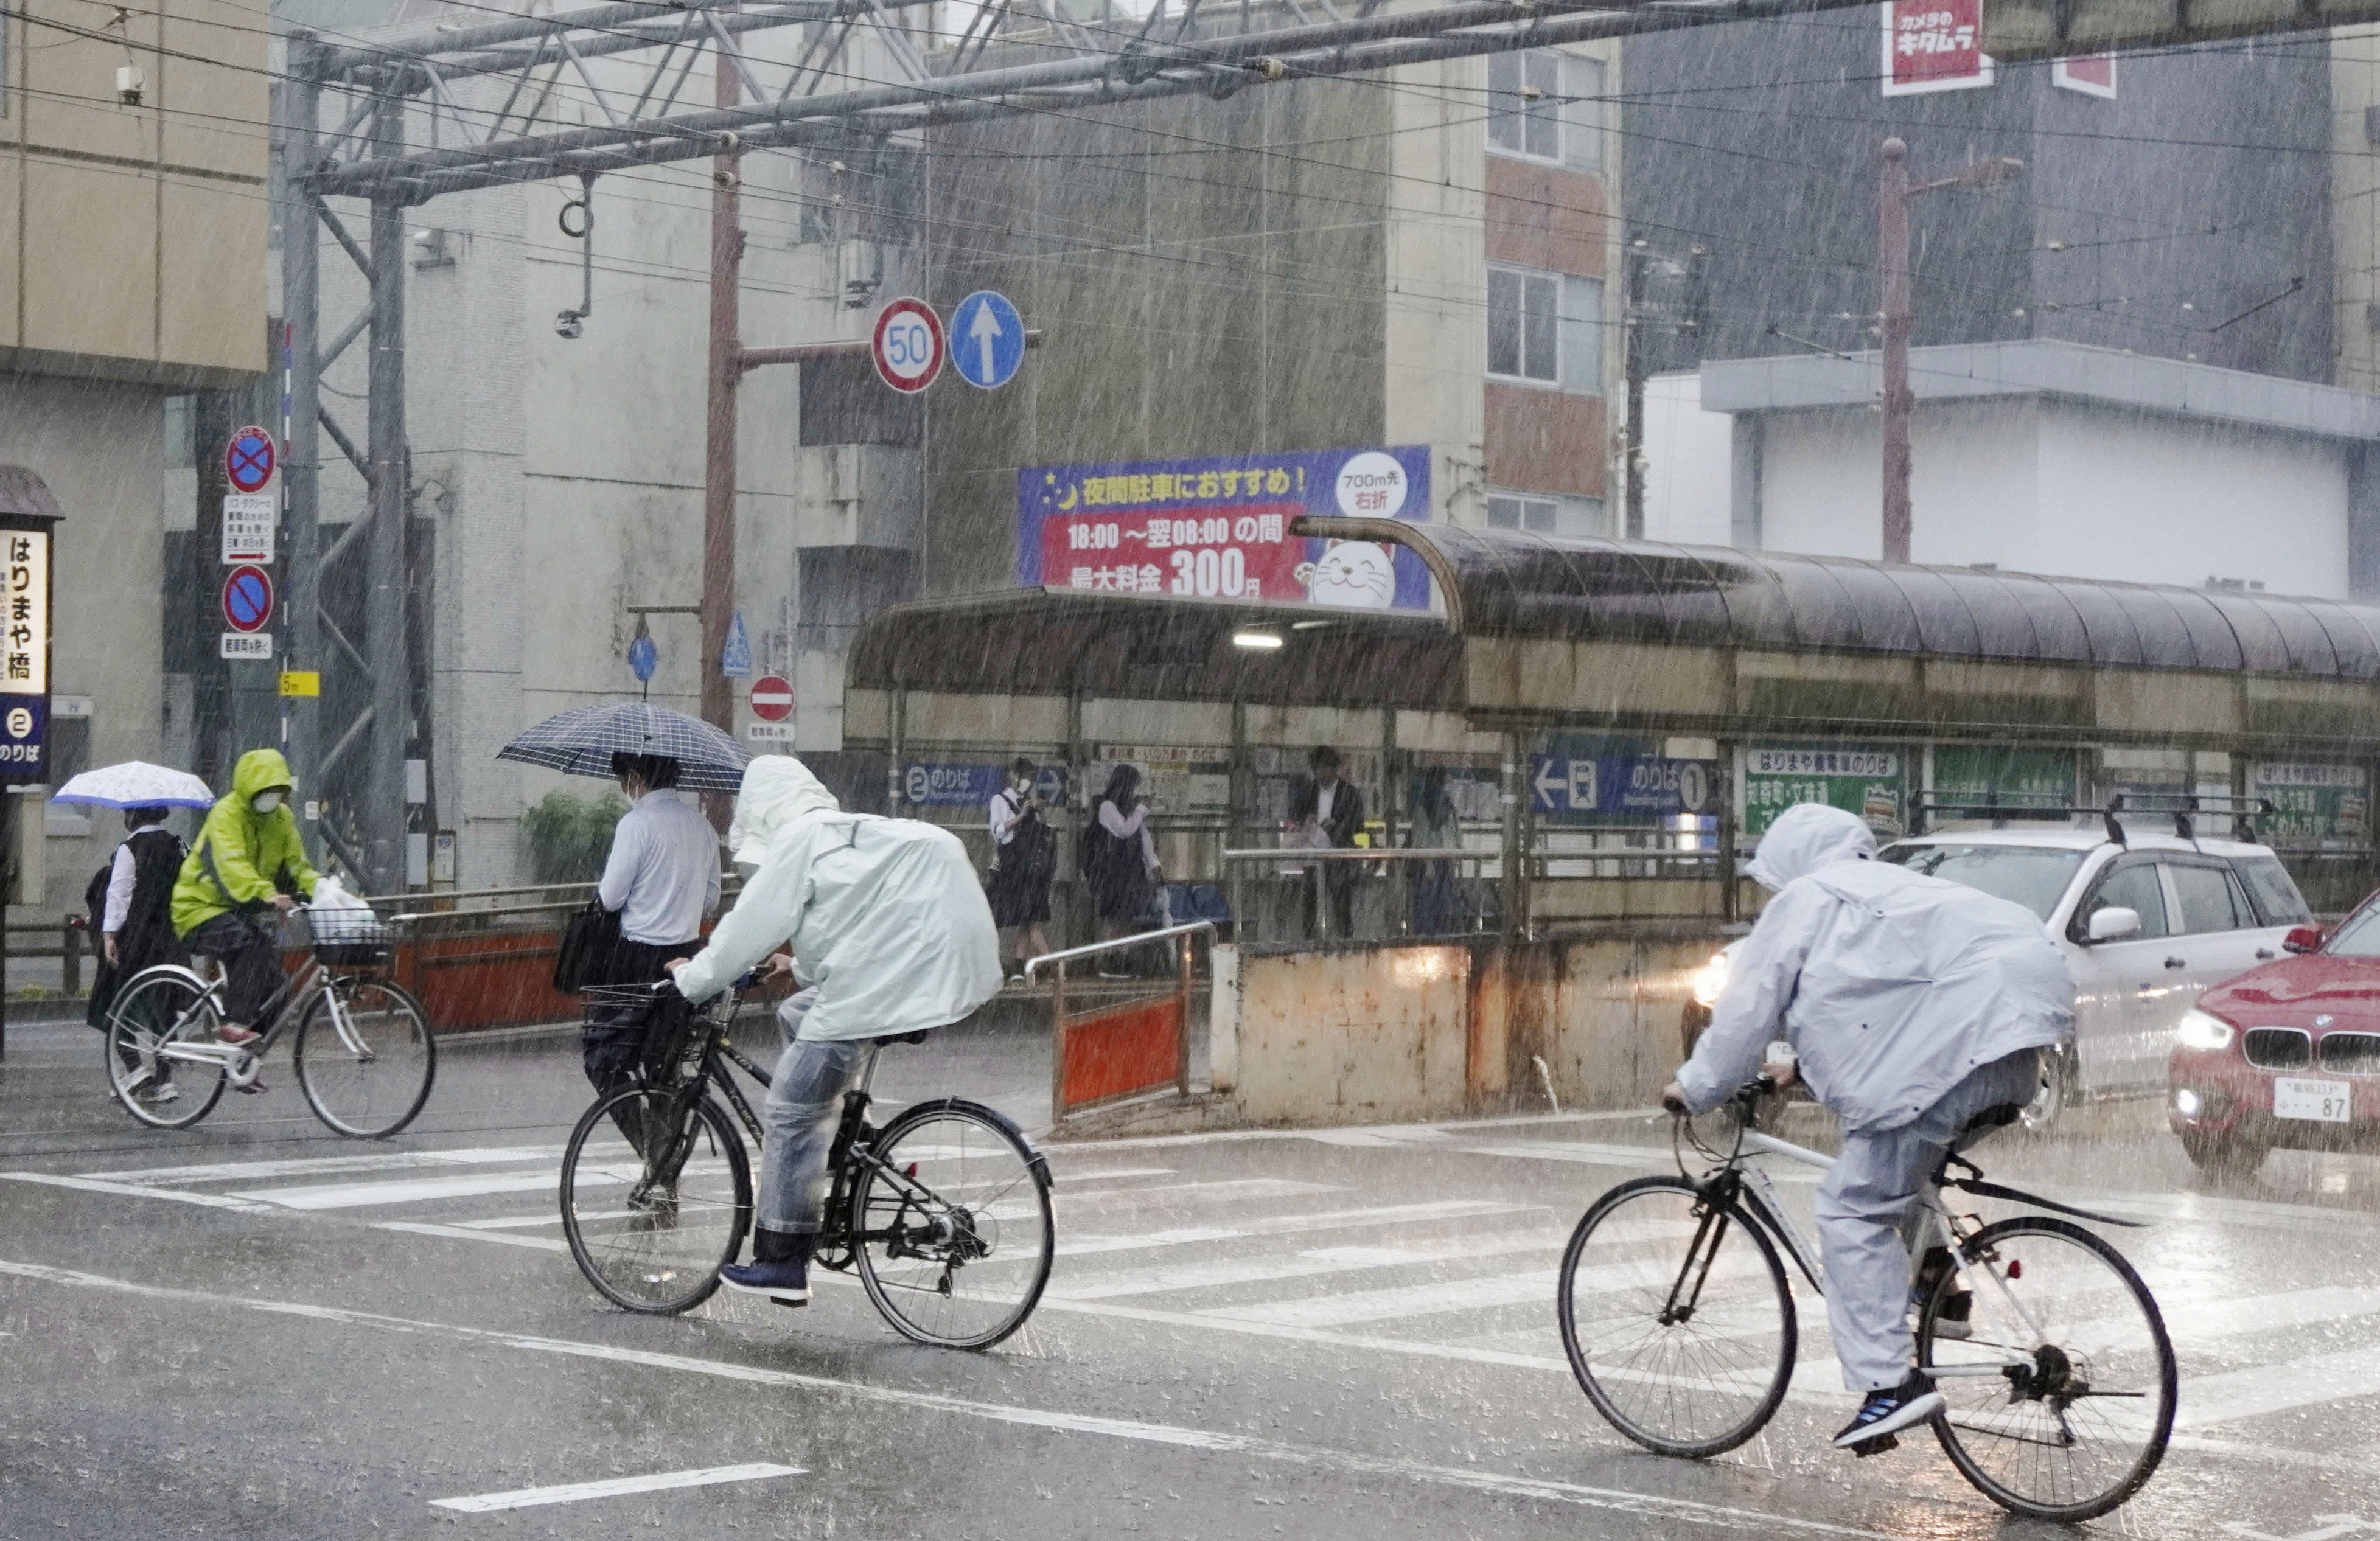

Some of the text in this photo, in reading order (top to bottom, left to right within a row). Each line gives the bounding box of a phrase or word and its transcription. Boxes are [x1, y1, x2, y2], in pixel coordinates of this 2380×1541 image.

[1899, 12, 1953, 30] カメラの
[1897, 25, 1975, 57] キタムラ
[888, 325, 927, 364] 50
[1344, 470, 1399, 488] 700m先
[1355, 490, 1388, 510] 右折
[1068, 523, 1120, 549] 18:00
[1234, 513, 1283, 544] の間
[1071, 563, 1163, 593] 最大料金
[9, 537, 32, 680] はりまや橋
[0, 744, 40, 763] のりば
[2323, 1097, 2345, 1118] 87
